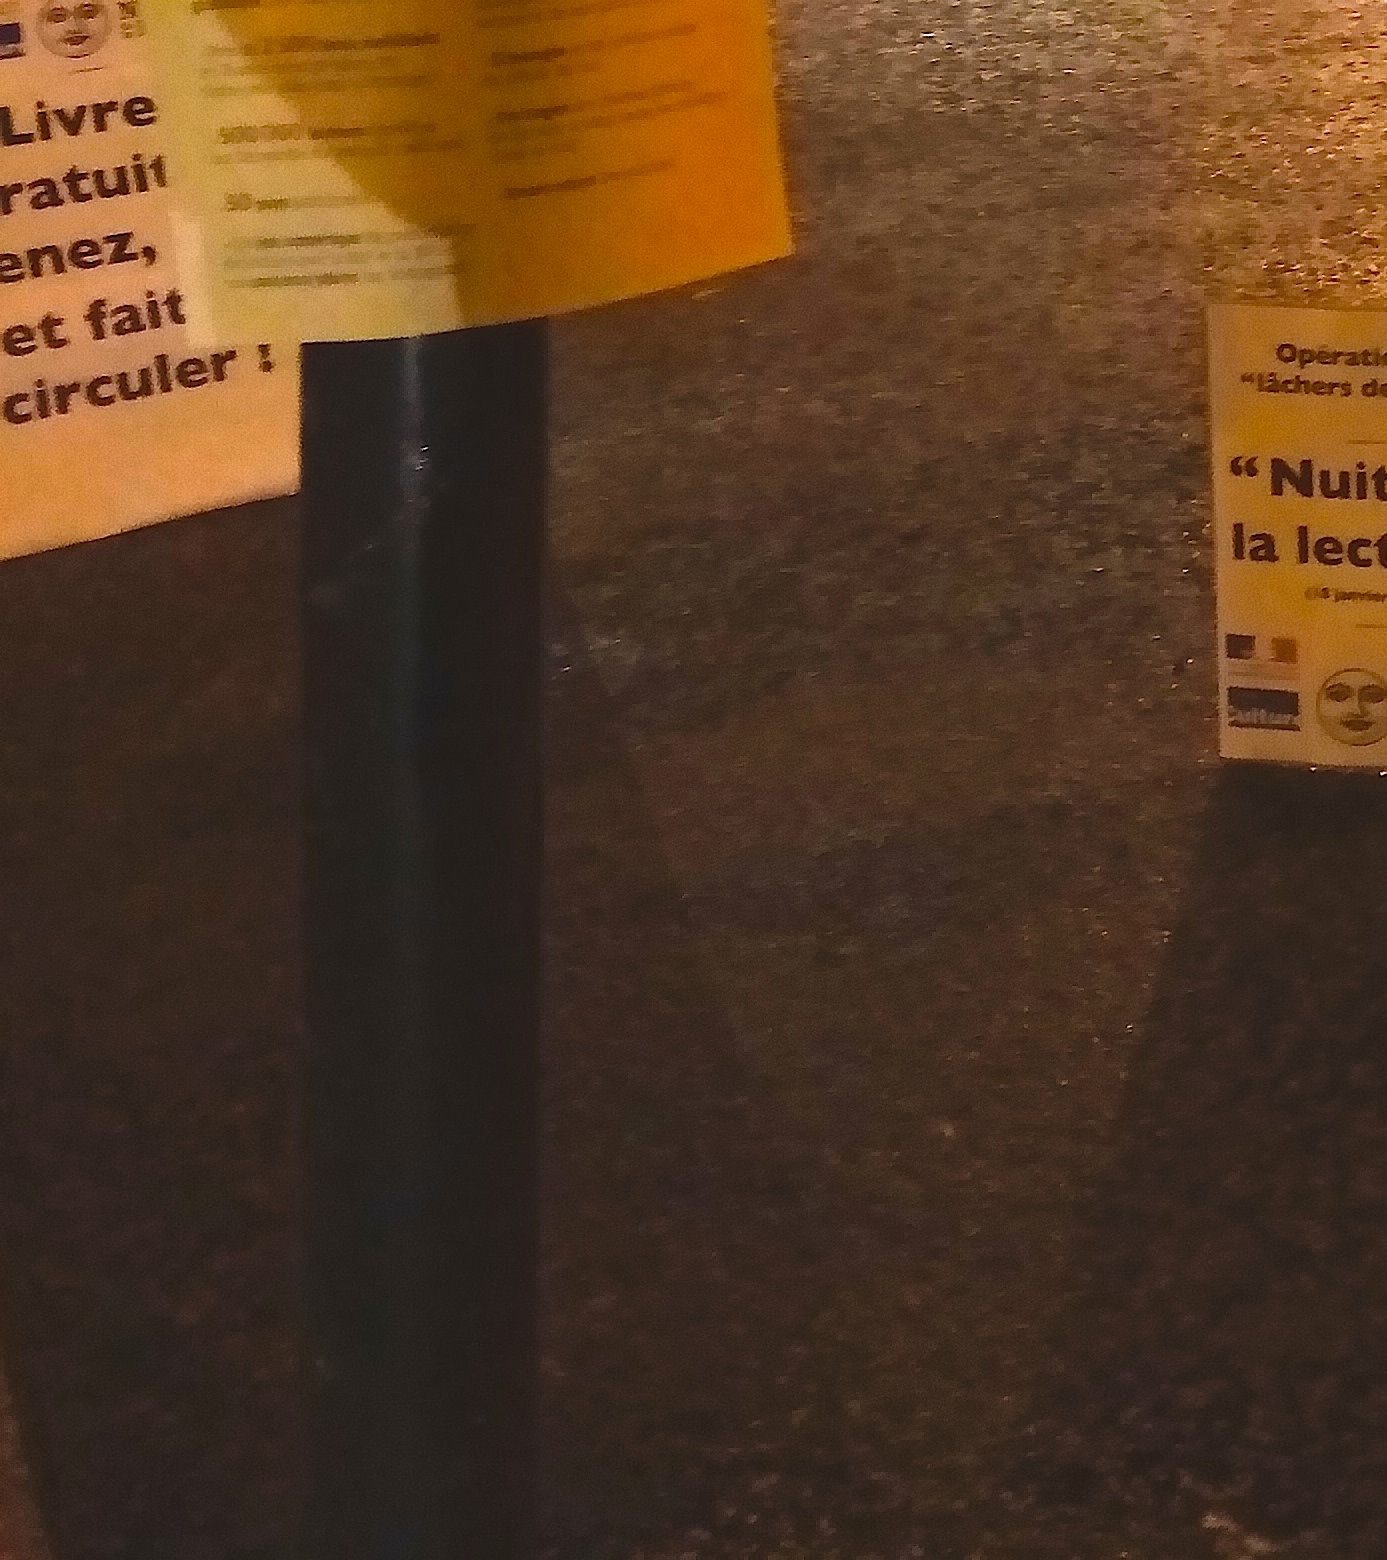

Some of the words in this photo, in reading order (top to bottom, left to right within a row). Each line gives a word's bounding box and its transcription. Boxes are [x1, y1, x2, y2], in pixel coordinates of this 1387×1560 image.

[2, 312, 70, 357] et
[3, 347, 237, 426] circuler
[1232, 522, 1280, 563] la
